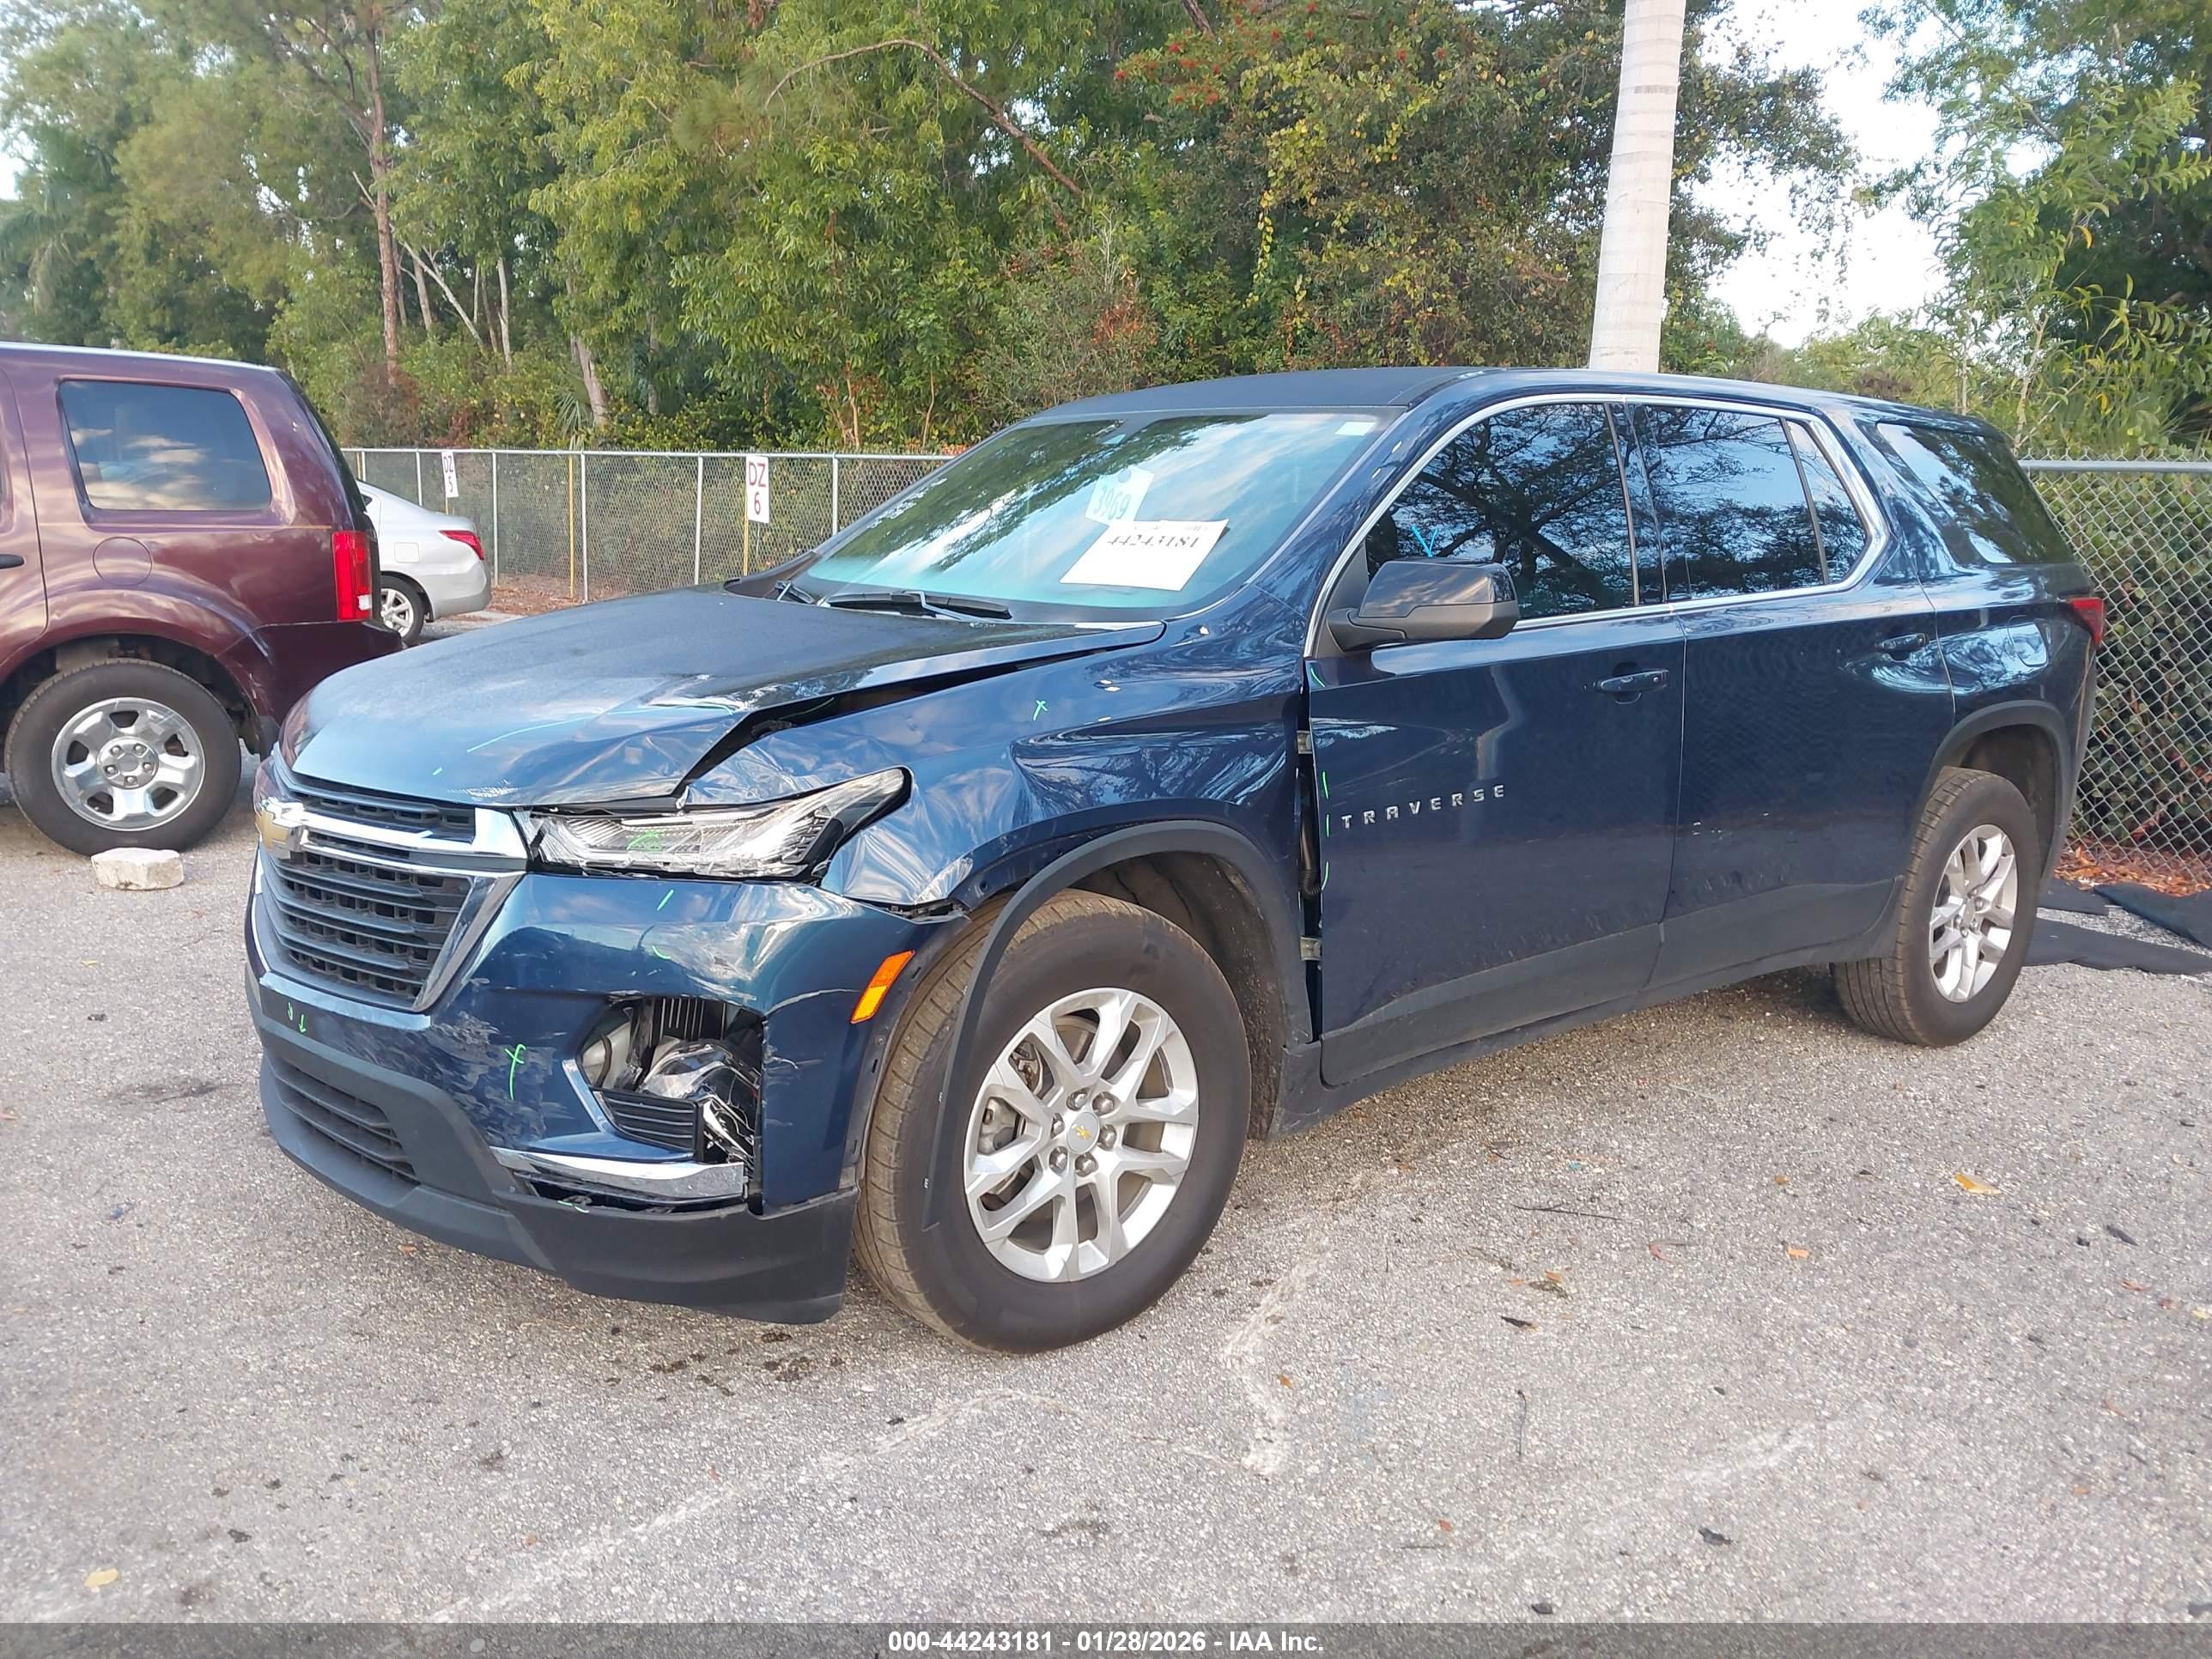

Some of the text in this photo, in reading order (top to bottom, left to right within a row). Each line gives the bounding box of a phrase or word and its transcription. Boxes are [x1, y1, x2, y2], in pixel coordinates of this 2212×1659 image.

[748, 461, 767, 488] DZ
[754, 491, 761, 515] 6
[1107, 534, 1200, 548] 44243181
[1340, 784, 1505, 830] TRAVERSE
